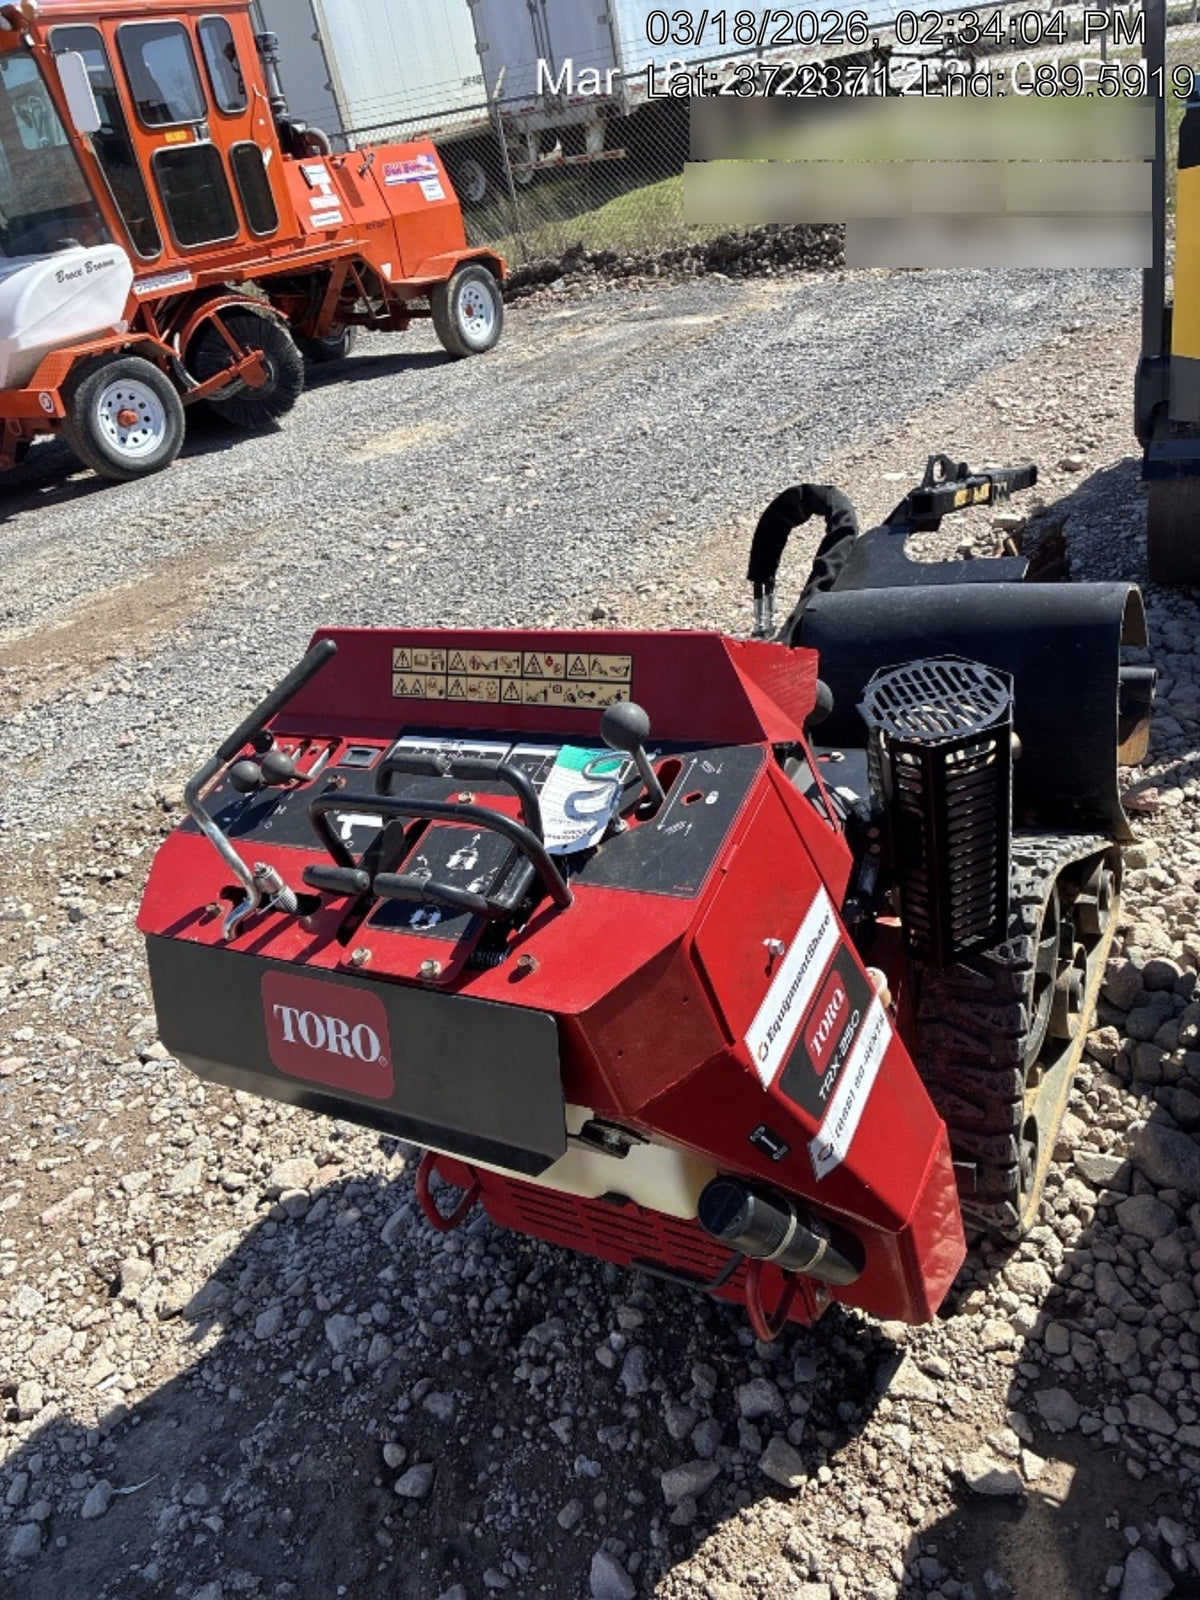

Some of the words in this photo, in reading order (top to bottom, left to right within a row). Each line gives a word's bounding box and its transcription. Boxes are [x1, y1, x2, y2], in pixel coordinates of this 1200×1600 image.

[766, 913, 831, 1044] EquipmentShare
[272, 1003, 381, 1063] TORO
[810, 986, 845, 1057] TORO
